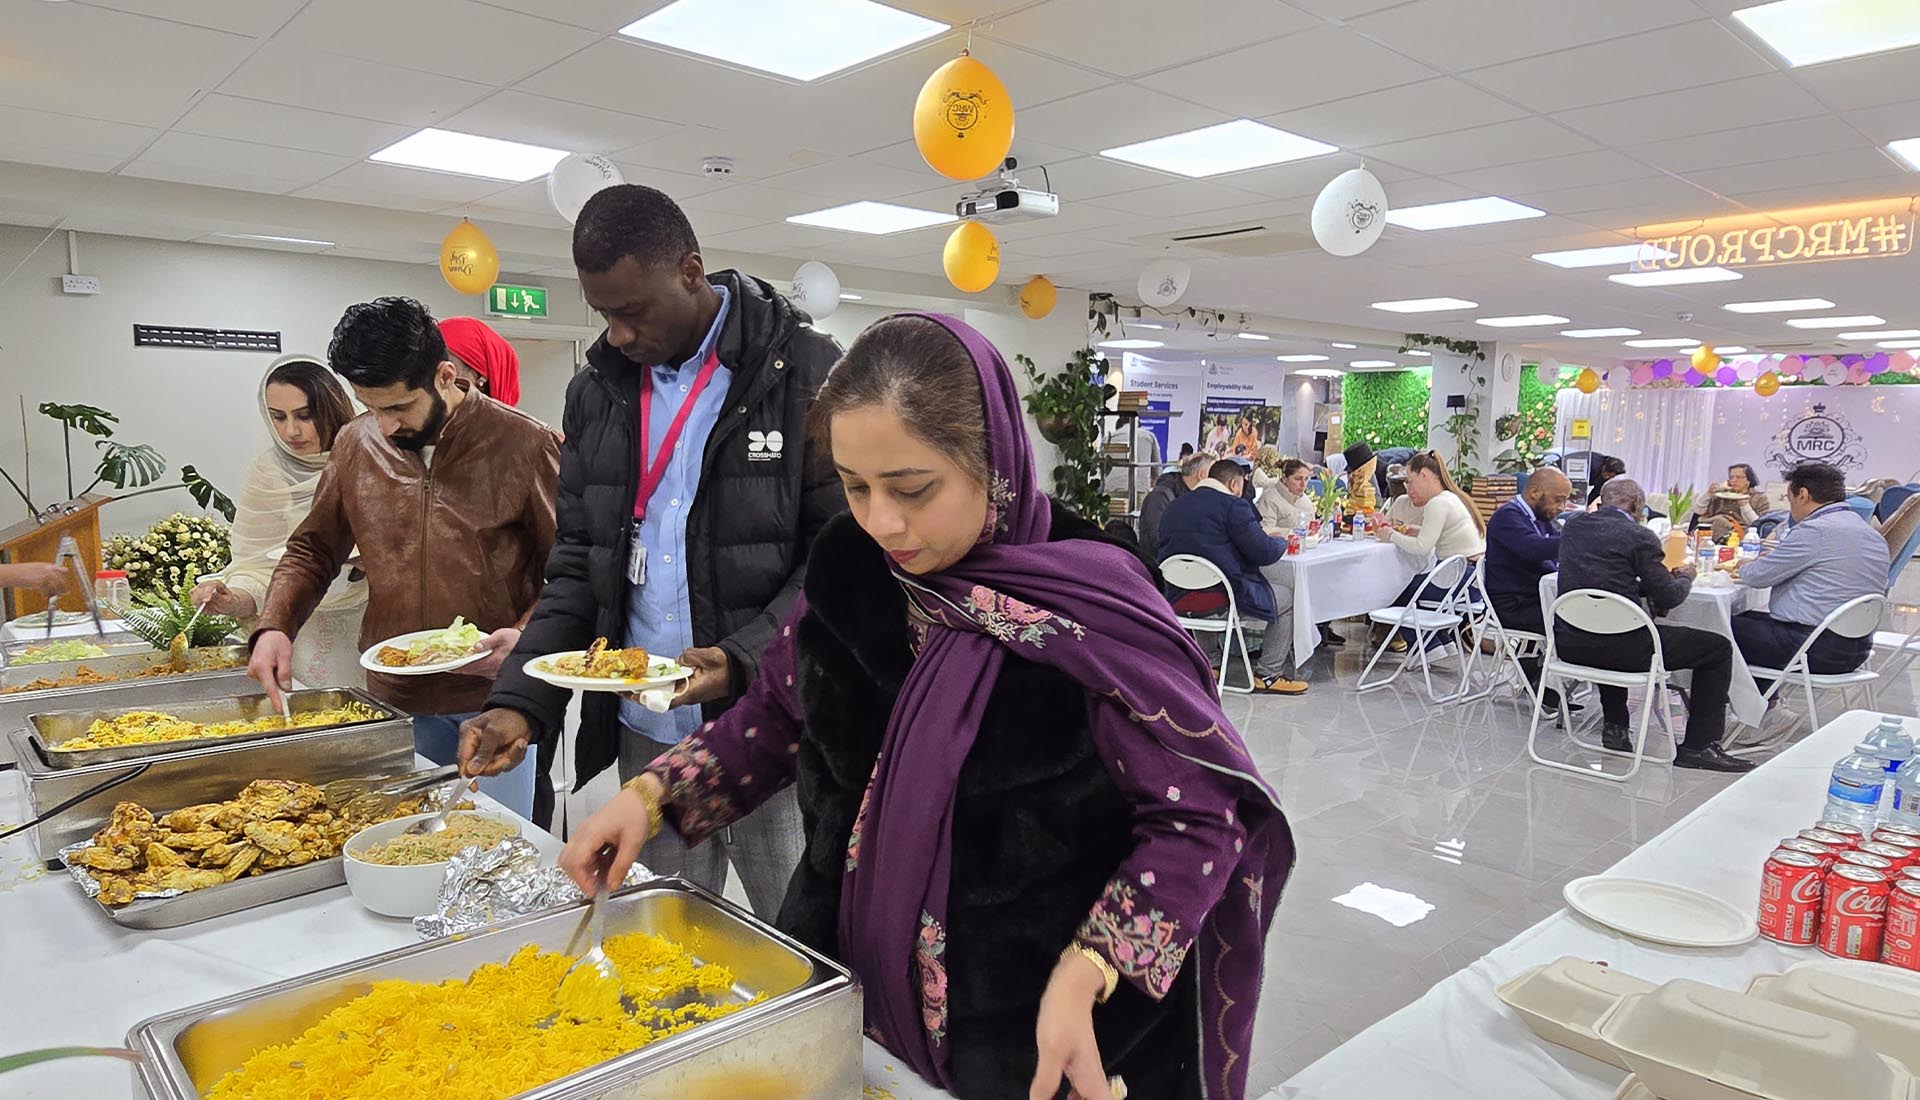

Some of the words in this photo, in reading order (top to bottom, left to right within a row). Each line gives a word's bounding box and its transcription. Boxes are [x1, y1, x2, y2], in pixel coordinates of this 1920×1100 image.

[1130, 379, 1153, 388] Student
[1154, 381, 1178, 390] Services
[1206, 382, 1241, 391] Employability
[1796, 440, 1835, 451] MRC
